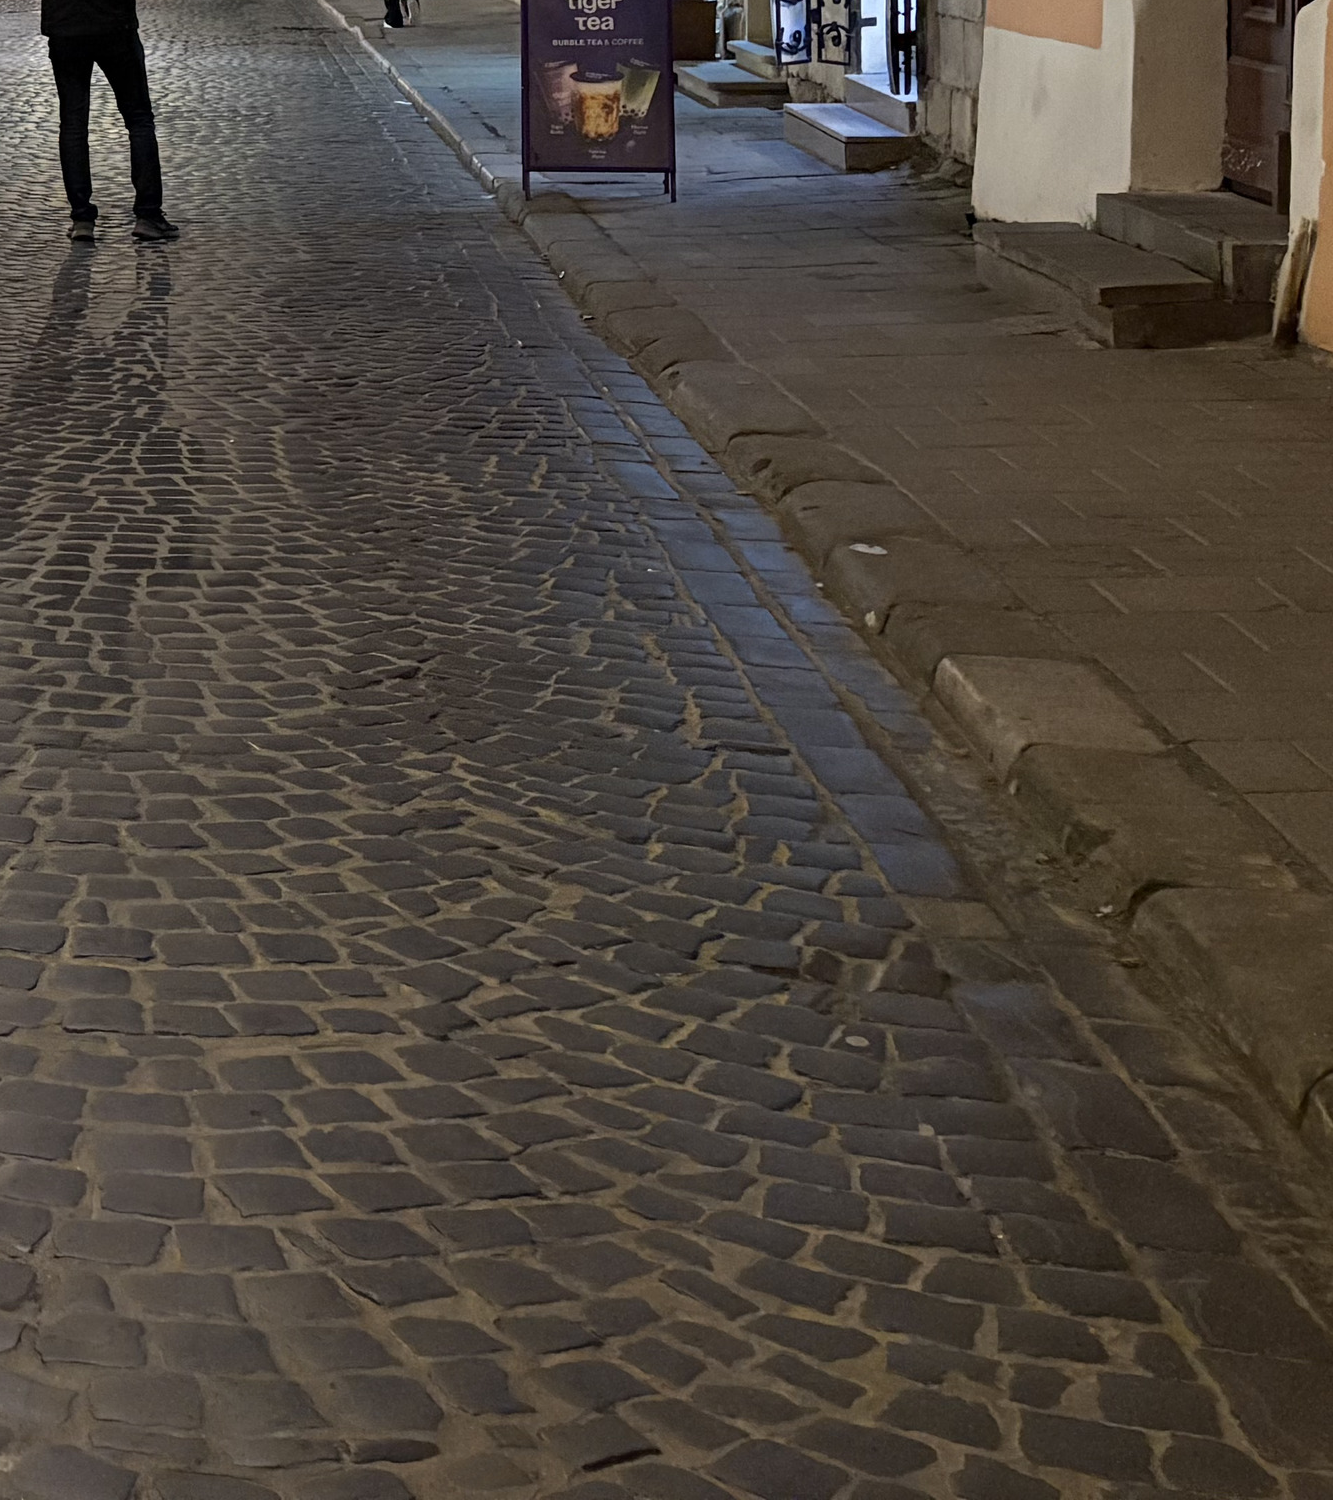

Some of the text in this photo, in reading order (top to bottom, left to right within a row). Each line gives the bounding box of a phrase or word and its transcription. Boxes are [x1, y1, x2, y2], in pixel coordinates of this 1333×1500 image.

[573, 16, 615, 31] tea
[552, 39, 585, 47] BUBBLE
[586, 38, 603, 46] TEA
[611, 38, 644, 46] COFFEE
